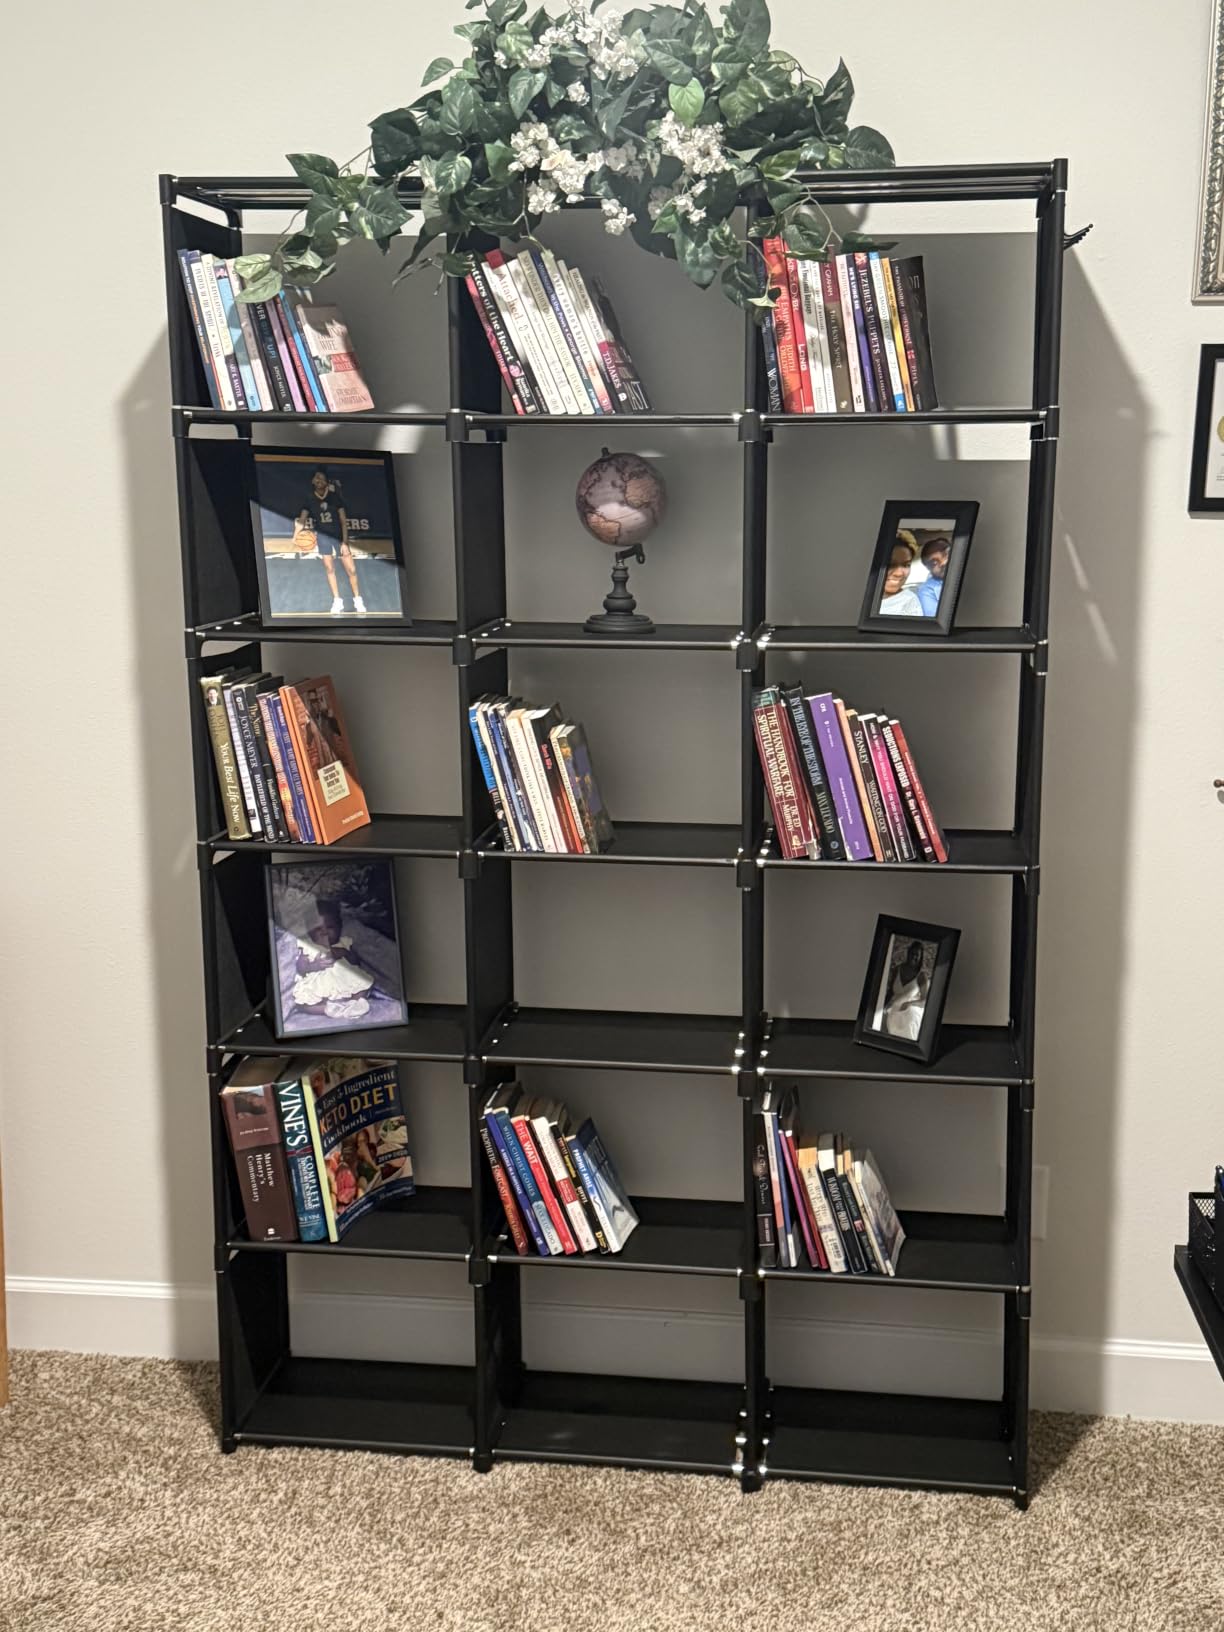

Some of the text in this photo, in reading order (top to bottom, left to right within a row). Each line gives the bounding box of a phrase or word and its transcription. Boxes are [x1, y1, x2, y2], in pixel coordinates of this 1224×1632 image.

[206, 266, 215, 286] DIVINE
[211, 286, 223, 319] REVELATION
[790, 283, 800, 313] OVER
[825, 269, 833, 296] GRAHAM
[551, 274, 589, 355] every woman's battle
[558, 312, 567, 328] Pews
[859, 269, 873, 312] JEZEBEL'S
[868, 315, 880, 354] PUPPETS
[879, 295, 889, 329] SMOOTHIE
[483, 298, 494, 310] of
[489, 311, 502, 330] the
[497, 330, 514, 361] Heart
[831, 325, 839, 345] HOLY
[267, 344, 277, 359] UP!
[559, 345, 571, 367] SAVIOR
[565, 333, 588, 380] George Bloomer
[786, 344, 798, 372] JUDITH
[798, 344, 807, 371] LONG
[833, 347, 841, 369] SPIRIT
[233, 379, 242, 397] BAXTER
[608, 365, 621, 389] JAKES
[320, 512, 332, 523] 12
[249, 704, 260, 718] The
[220, 743, 231, 765] YOUR
[240, 715, 251, 739] JOYCE
[246, 741, 258, 768] MEYER
[757, 714, 785, 797] SPIRITUAL WARFARE
[766, 711, 794, 798] THE HANDBOOK FOR
[790, 697, 801, 706] IN
[806, 757, 822, 786] STORM
[854, 731, 868, 765] STANLEY
[882, 726, 910, 788] SEDUCTIONS EXPOSED
[225, 765, 236, 785] Best
[255, 774, 266, 807] BATTLEFIELD
[267, 778, 276, 798] Franklin
[226, 785, 239, 803] Life
[869, 781, 887, 833] WAITING ON GOD
[880, 762, 888, 781] SHOULD
[888, 794, 894, 802] ON
[899, 837, 908, 858] HUSBAND
[907, 799, 916, 811] Gary
[231, 804, 241, 823] NOW
[782, 804, 795, 832] MURPHY
[790, 805, 801, 828] DR. ED
[816, 792, 834, 834] MAX LUCADO
[277, 1081, 308, 1147] VINE'S
[318, 1083, 397, 1136] KETO DIET
[322, 1115, 368, 1148] Cookbook
[516, 1123, 538, 1165] THE WAIT
[255, 1154, 266, 1185] Henry's
[264, 1153, 275, 1187] Matthew
[480, 1128, 508, 1198] PROPHETIC FORECAST
[503, 1126, 537, 1197] WHEN CHRIST COMES
[503, 1152, 511, 1167] NEEDLE
[512, 1175, 522, 1195] HAYSTACK
[573, 1149, 586, 1173] PROPHET
[583, 1173, 593, 1188] ARISE
[247, 1155, 259, 1202] Commentary
[305, 1155, 320, 1208] COMPLETE
[542, 1219, 556, 1244] LUCADO
